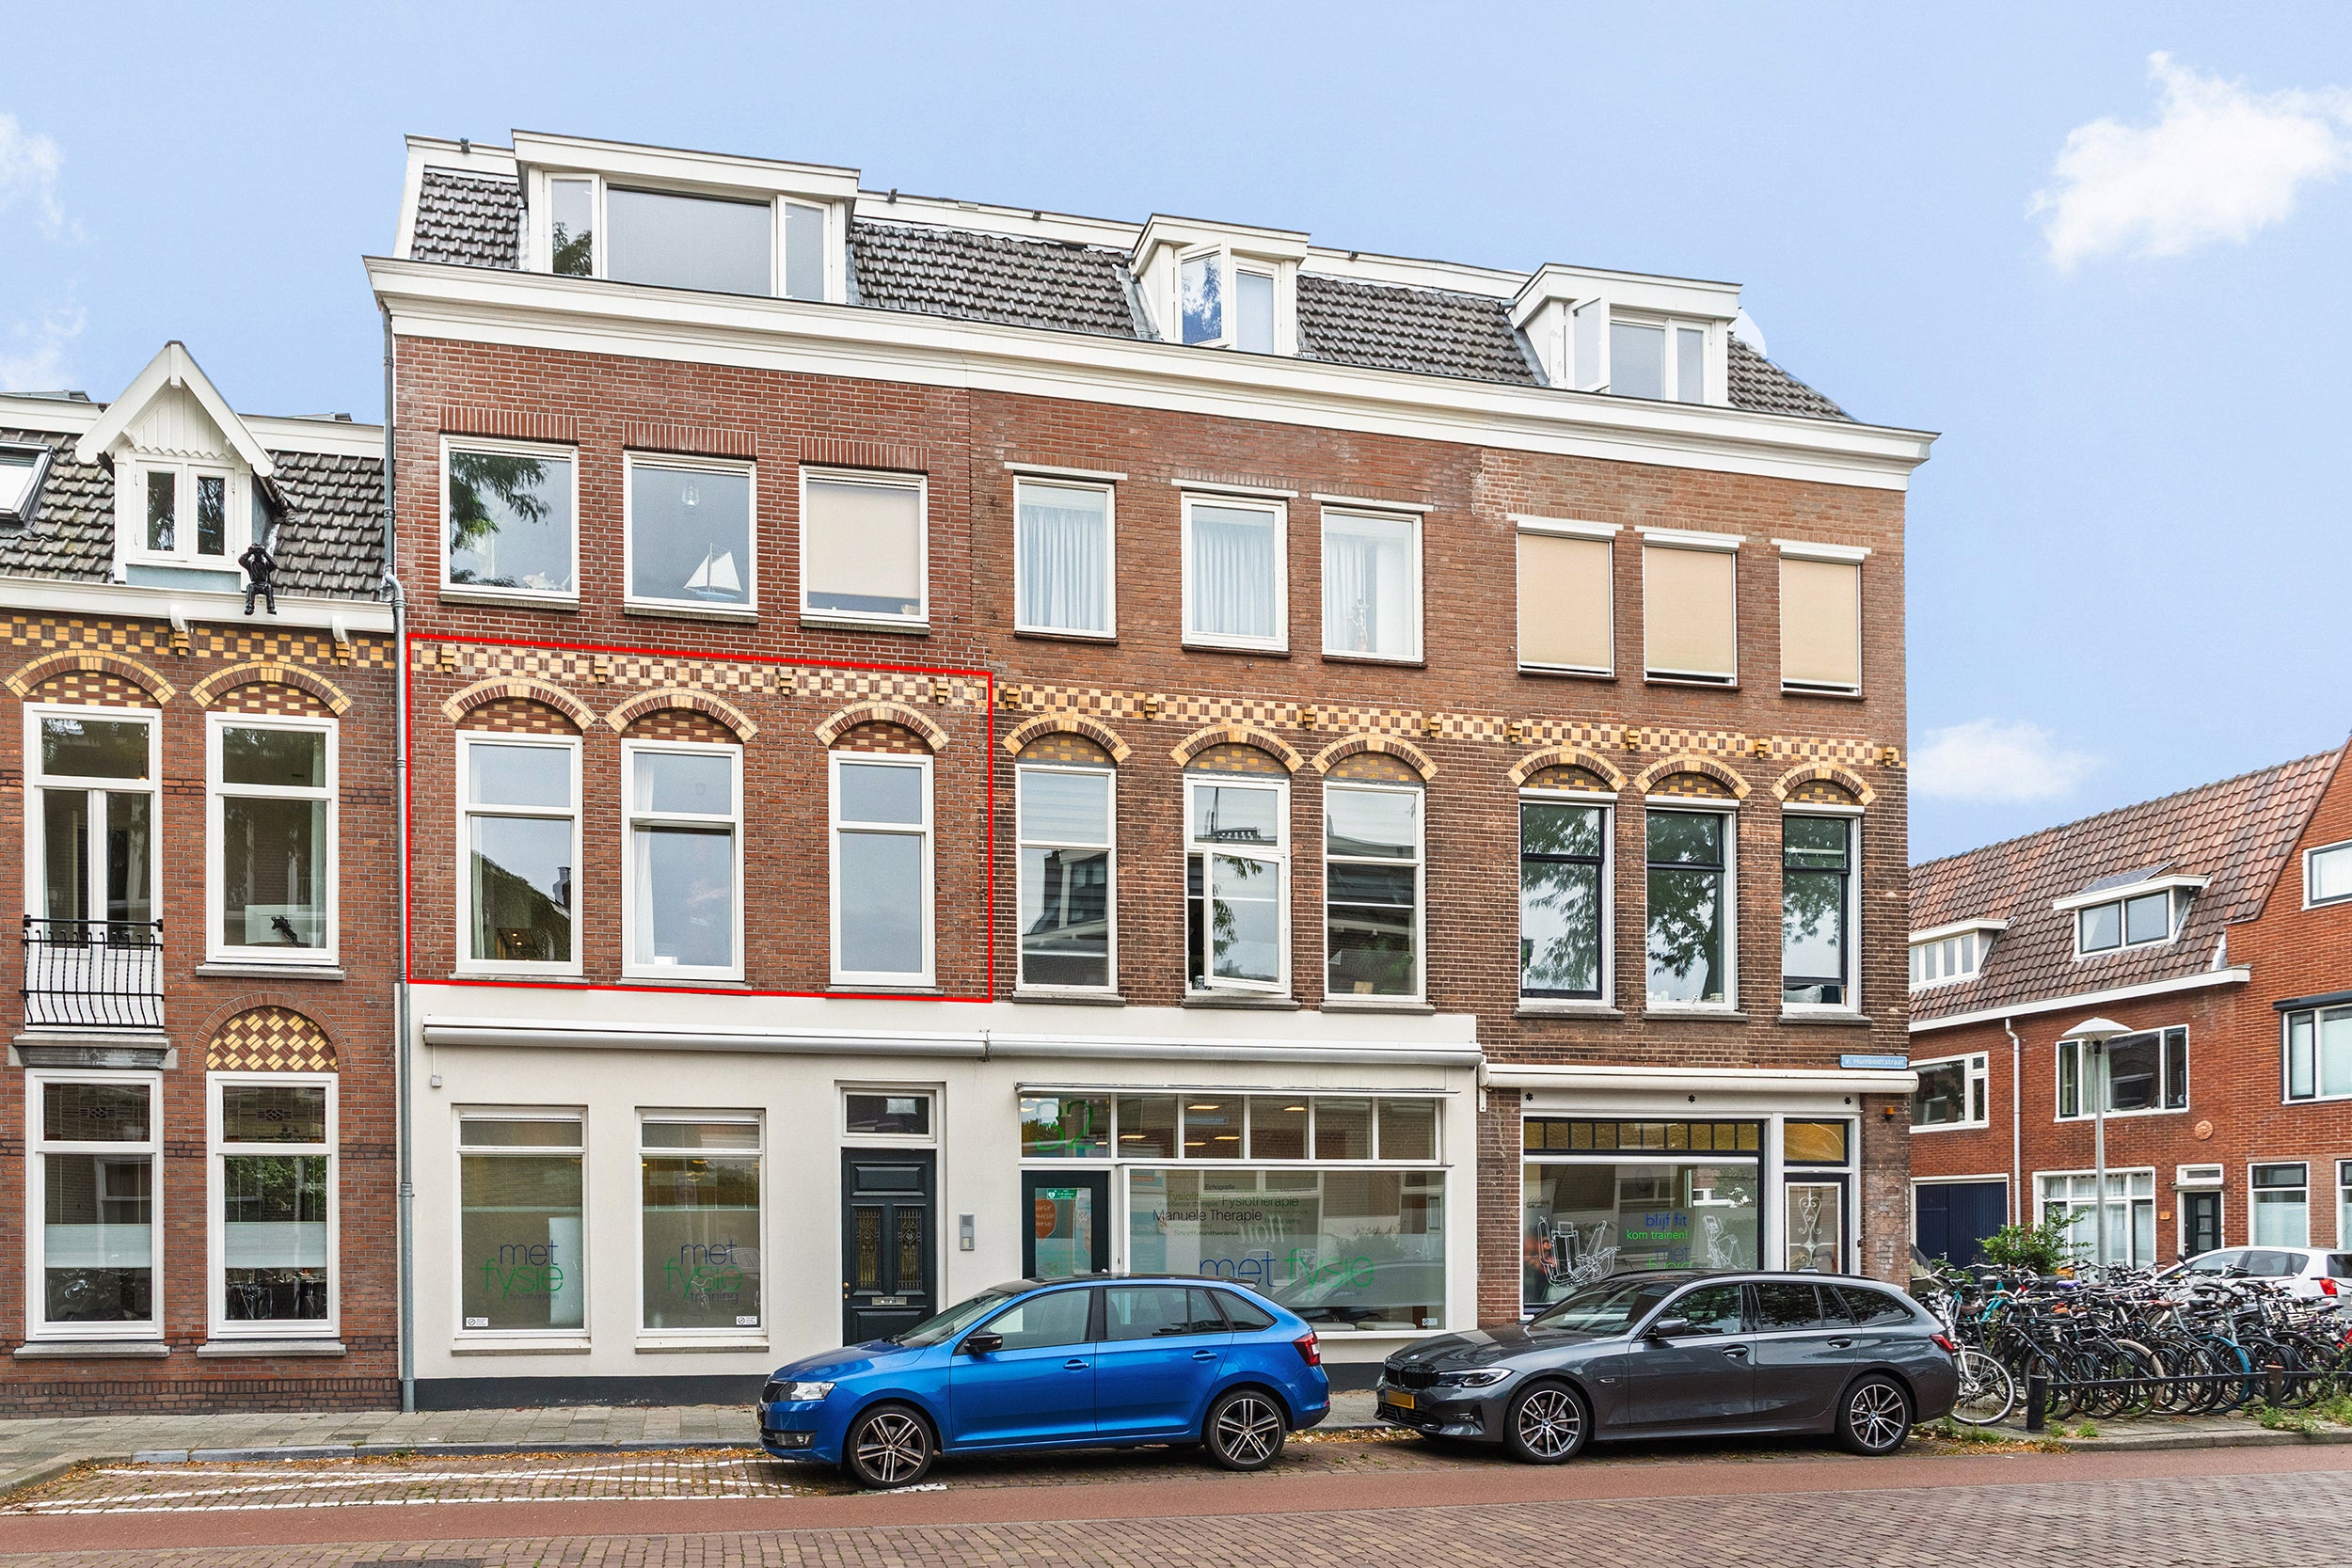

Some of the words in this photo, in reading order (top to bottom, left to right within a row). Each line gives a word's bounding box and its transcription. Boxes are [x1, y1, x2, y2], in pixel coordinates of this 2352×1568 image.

[1036, 1101, 1095, 1150] 32
[1222, 1196, 1299, 1209] Fysiotherapie
[1152, 1209, 1207, 1222] Manuele
[1209, 1209, 1263, 1223] Therapie
[1645, 1212, 1671, 1230] blijf
[1675, 1212, 1688, 1227] fit
[1626, 1228, 1648, 1240] kom
[1651, 1228, 1689, 1240] trainen!
[500, 1240, 559, 1266] met
[680, 1239, 739, 1265] met
[1656, 1245, 1691, 1262] met
[479, 1258, 564, 1299] fysie
[662, 1258, 743, 1299] fysie
[1200, 1251, 1277, 1288] met
[1283, 1248, 1375, 1298] fysie
[690, 1291, 739, 1306] training
